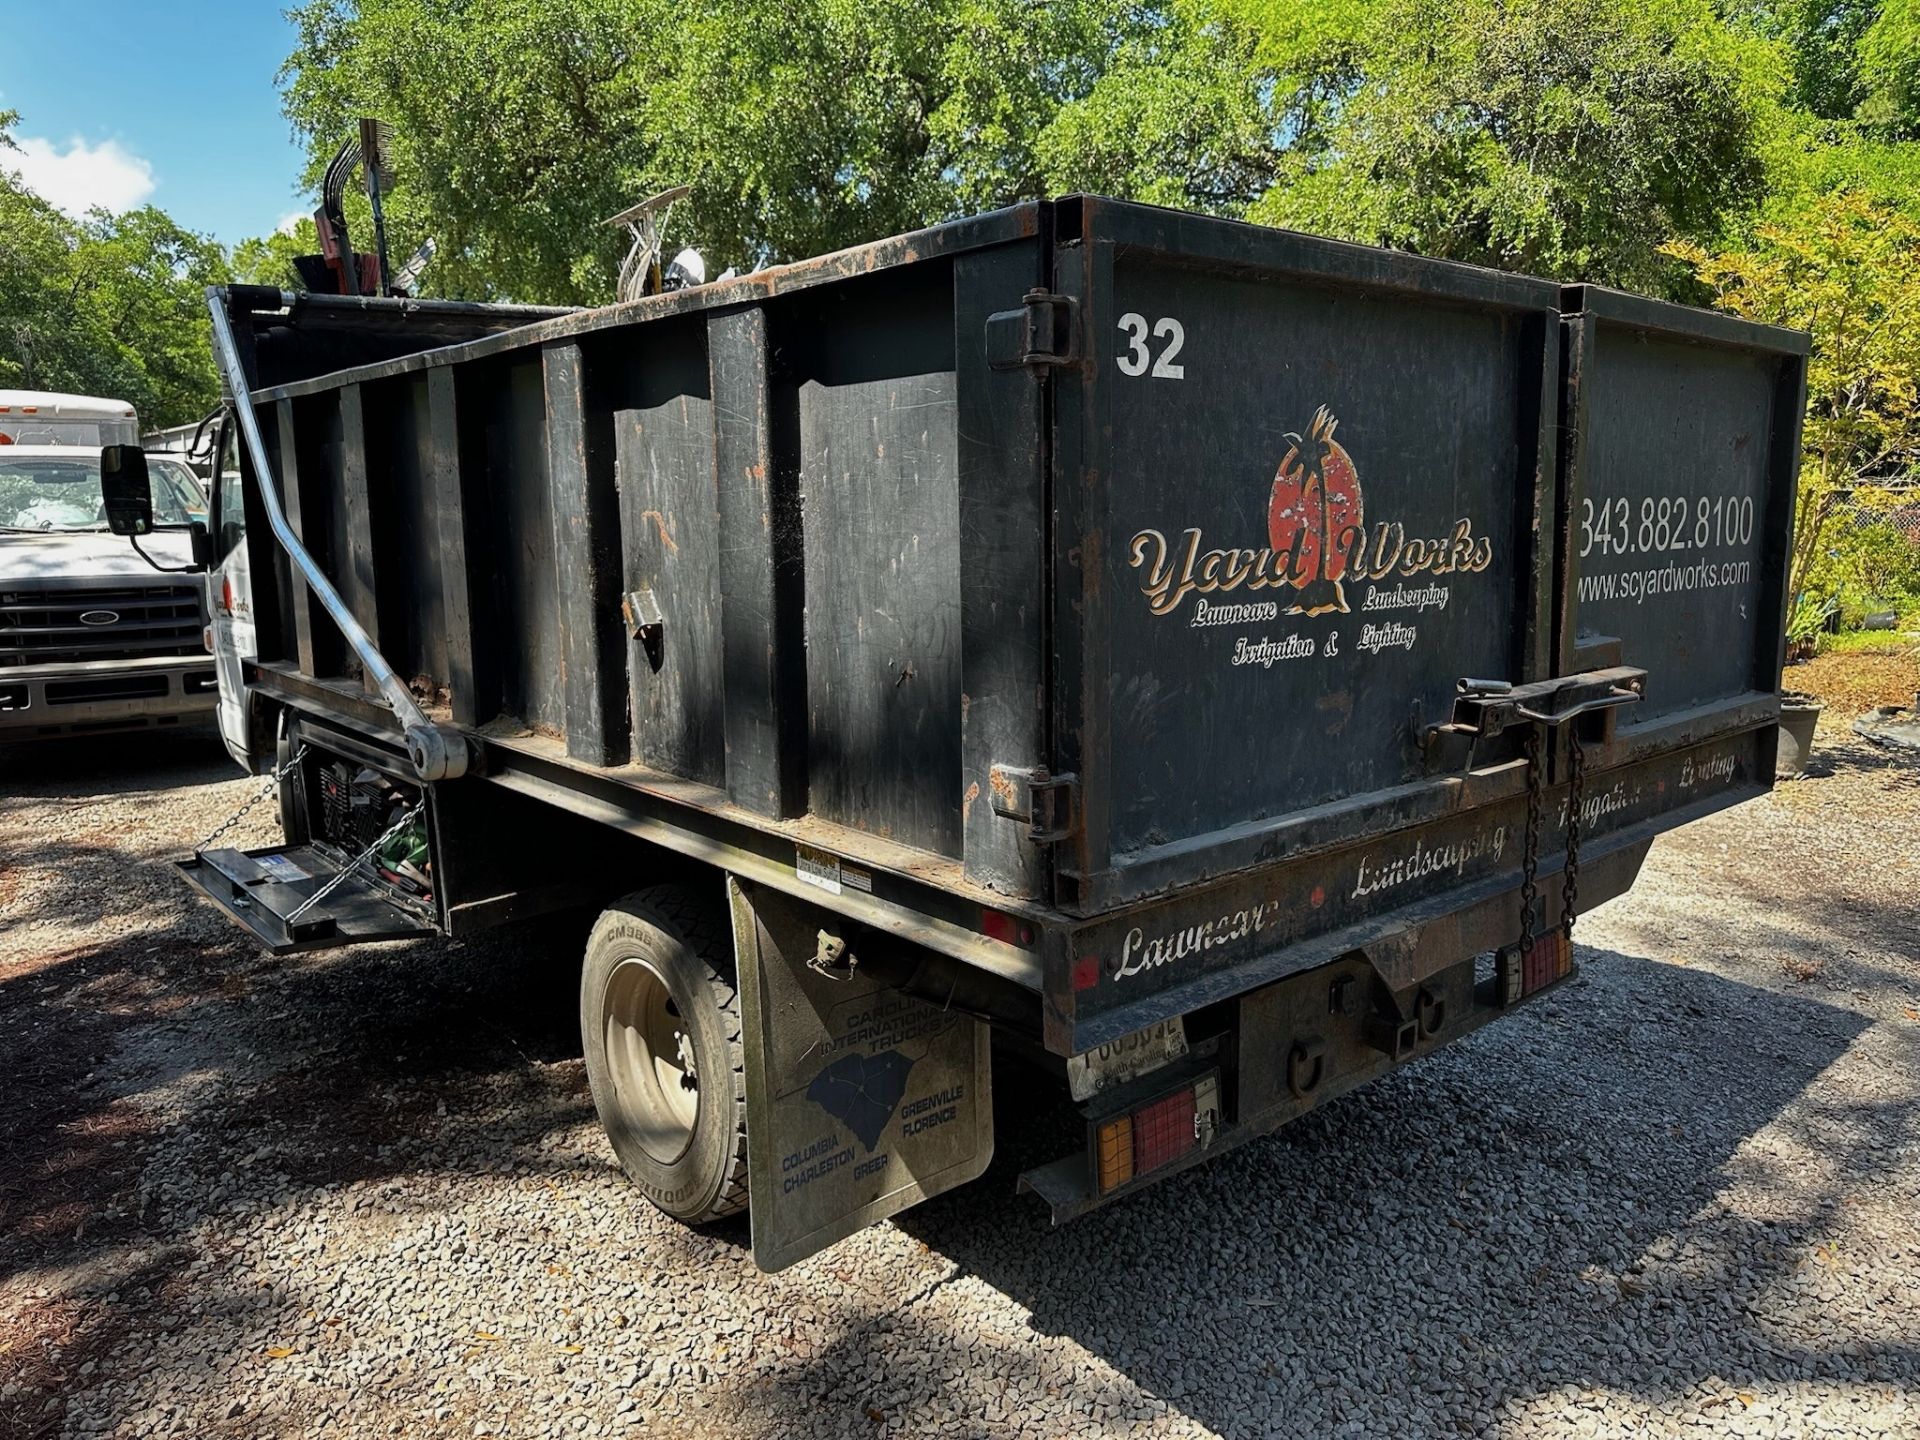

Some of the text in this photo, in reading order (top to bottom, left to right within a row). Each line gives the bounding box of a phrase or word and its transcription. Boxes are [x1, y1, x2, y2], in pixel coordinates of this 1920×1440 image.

[1116, 312, 1186, 380] 32
[1580, 496, 1753, 558] 343.882.8100
[1129, 517, 1493, 616] Yard Works
[1577, 557, 1750, 605] www.scyardworks.com
[1190, 582, 1449, 628] Lawncare Landscaping
[1231, 621, 1416, 668] Irrigation & Lighting
[820, 1007, 942, 1056] INTERNATIONA
[868, 1019, 942, 1053] TRUCKS
[902, 1085, 963, 1119] GREENVILLE
[903, 1106, 956, 1138] FLORENCE
[782, 1134, 839, 1172] COLUMBIA
[783, 1147, 889, 1193] CHARLESTON GREER
